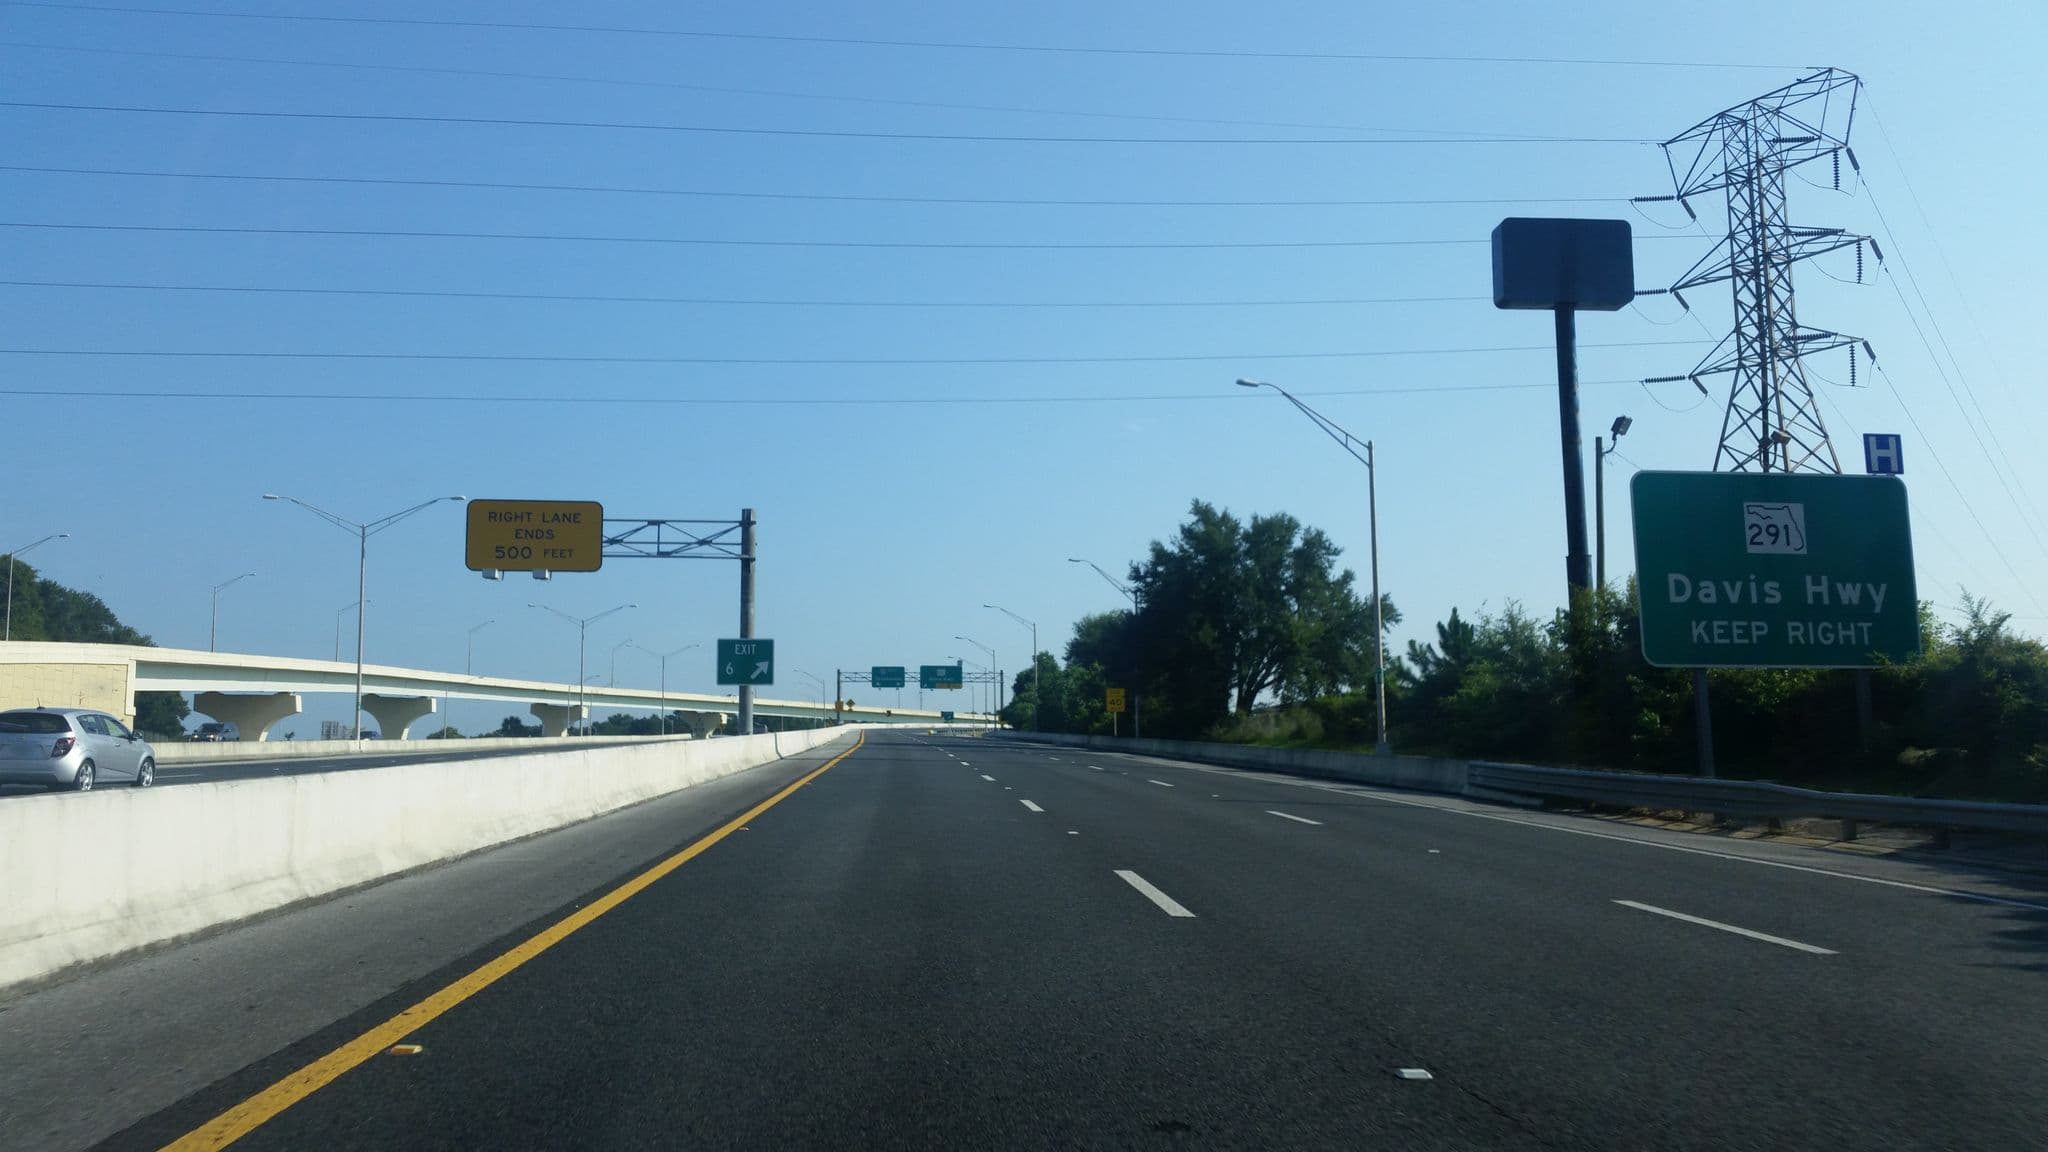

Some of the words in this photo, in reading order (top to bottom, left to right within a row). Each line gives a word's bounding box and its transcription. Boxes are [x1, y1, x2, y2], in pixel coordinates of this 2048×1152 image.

[1869, 436, 1899, 471] H
[488, 511, 533, 522] RIGHT
[542, 512, 582, 524] LANE
[515, 528, 554, 540] ENDS
[1748, 523, 1790, 546] 291
[495, 546, 532, 559] 500
[543, 548, 574, 559] FEET
[1667, 573, 1782, 604] Davis
[1805, 575, 1888, 613] Hwy
[1691, 620, 1769, 644] KEEP
[1787, 621, 1873, 645] RIGHT
[735, 644, 757, 655] EXIT
[726, 662, 734, 675] 6
